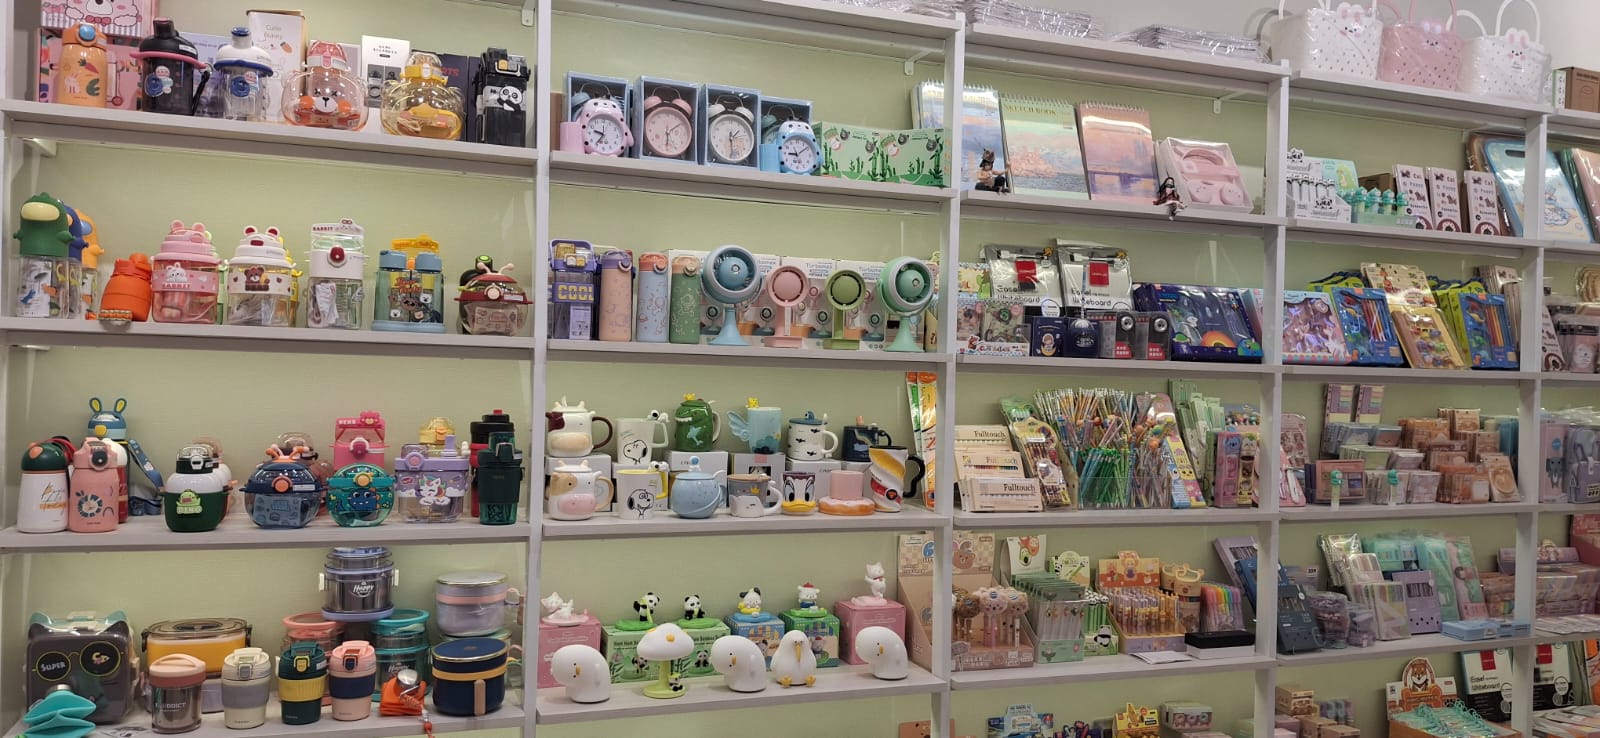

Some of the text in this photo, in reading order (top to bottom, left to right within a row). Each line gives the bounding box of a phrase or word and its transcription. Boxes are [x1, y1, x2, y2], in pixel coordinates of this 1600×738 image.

[1004, 104, 1057, 116] SKETCH BOOK
[558, 285, 594, 301] COOL
[986, 456, 1017, 465] Fulltouch
[1004, 484, 1036, 492] Fulltouch
